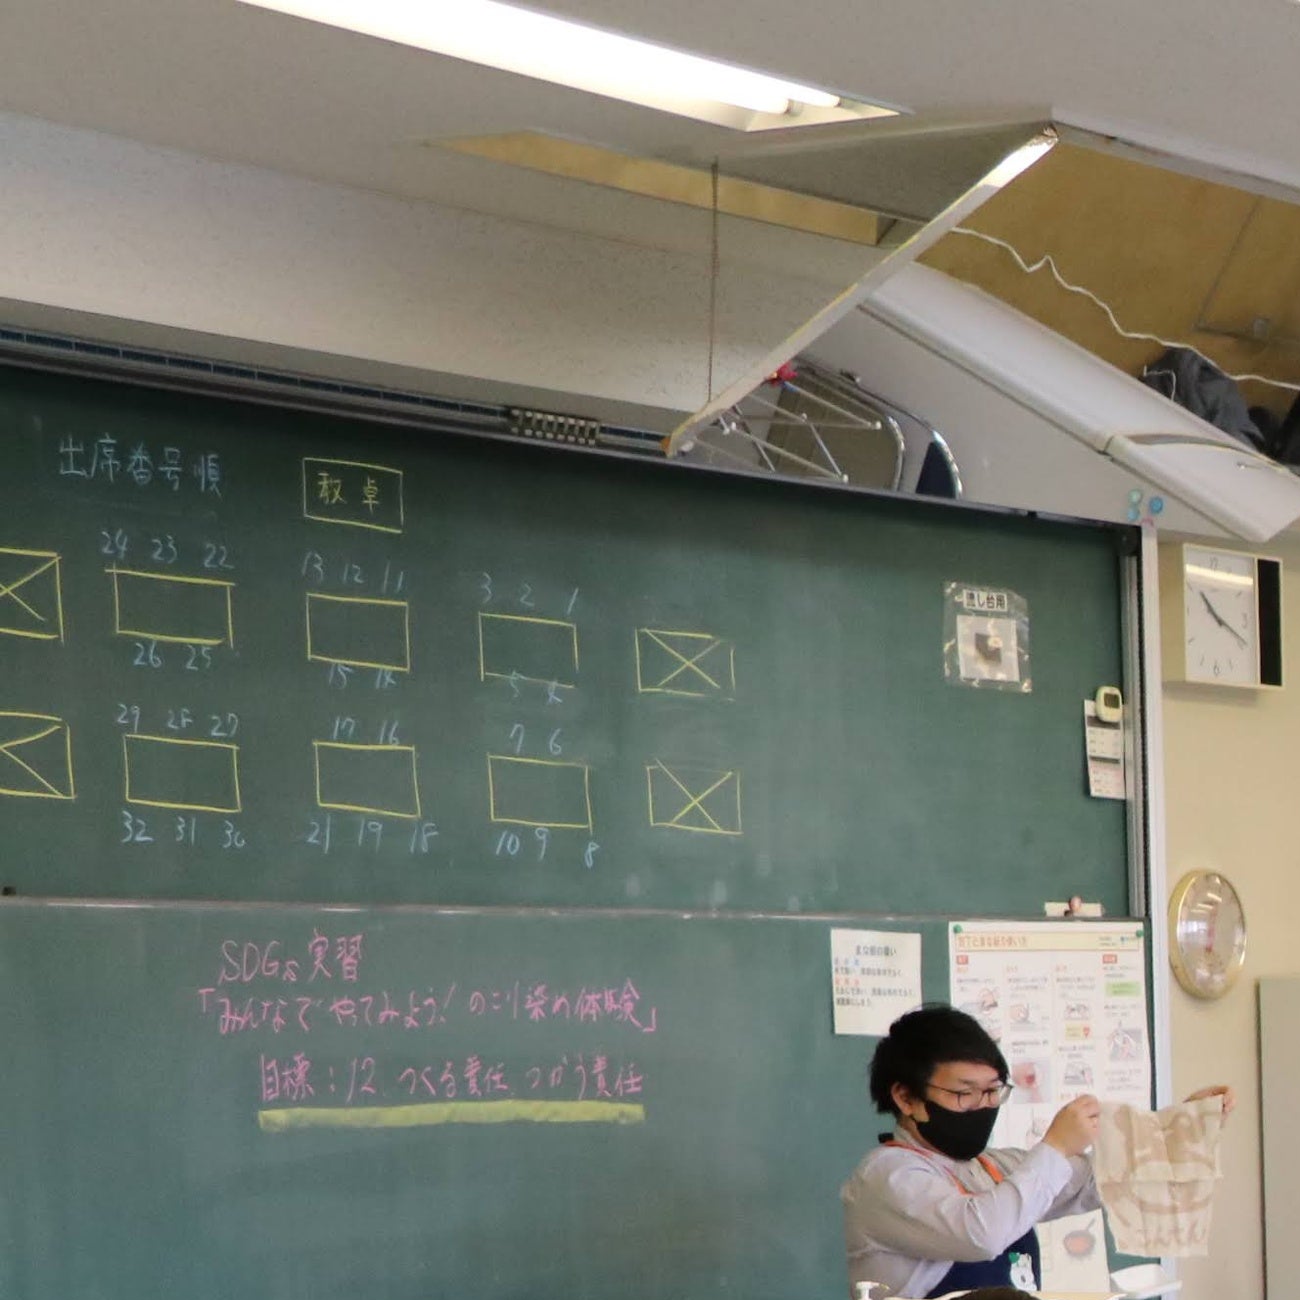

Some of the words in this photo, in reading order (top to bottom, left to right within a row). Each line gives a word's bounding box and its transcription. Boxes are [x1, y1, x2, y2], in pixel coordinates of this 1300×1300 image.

[58, 432, 222, 499] 出席番号順
[101, 528, 128, 560] 24
[151, 535, 178, 564] 23
[203, 543, 235, 569] 22
[302, 551, 324, 583] 13
[342, 563, 364, 584] 12
[382, 560, 404, 593] 11
[480, 571, 493, 604] 3
[519, 583, 536, 607] 2
[566, 587, 579, 615] 1
[133, 640, 163, 669] 26
[185, 643, 215, 671] 25
[328, 664, 353, 690] 15
[116, 702, 142, 735] 29
[210, 711, 241, 738] 27
[333, 715, 357, 741] 17
[379, 719, 400, 745] 16
[509, 723, 526, 754] 7
[549, 727, 563, 755] 6
[121, 809, 154, 844] 32
[175, 816, 197, 846] 31
[221, 819, 246, 850] 30
[306, 814, 332, 855] 21
[357, 817, 384, 851] 19
[495, 830, 521, 856] 10
[534, 827, 549, 862] 9
[583, 840, 600, 868] 8
